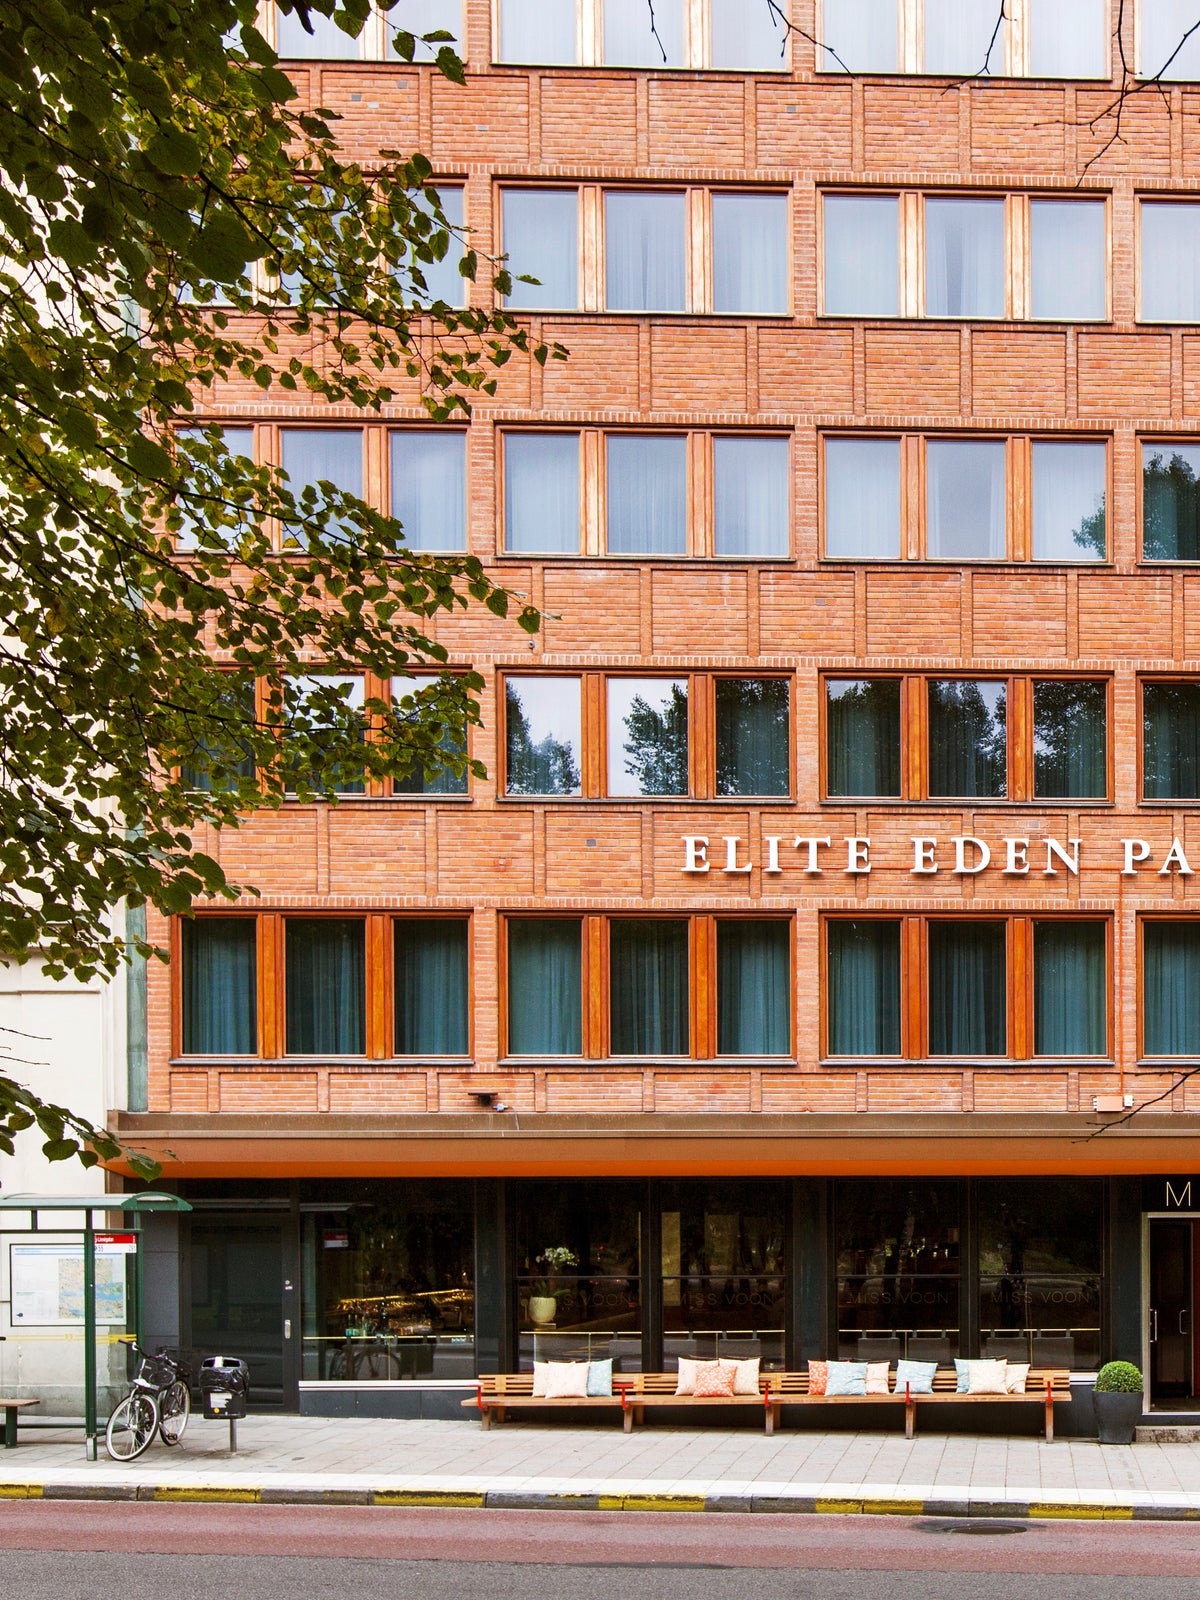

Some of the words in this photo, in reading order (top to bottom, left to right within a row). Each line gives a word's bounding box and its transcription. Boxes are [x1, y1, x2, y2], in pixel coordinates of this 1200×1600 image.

[681, 834, 872, 874] ELITE
[909, 835, 1083, 876] EDEN
[725, 1292, 774, 1306] VOON
[900, 1291, 949, 1305] VOON
[991, 1291, 1033, 1305] MISS
[1040, 1290, 1090, 1304] VOON
